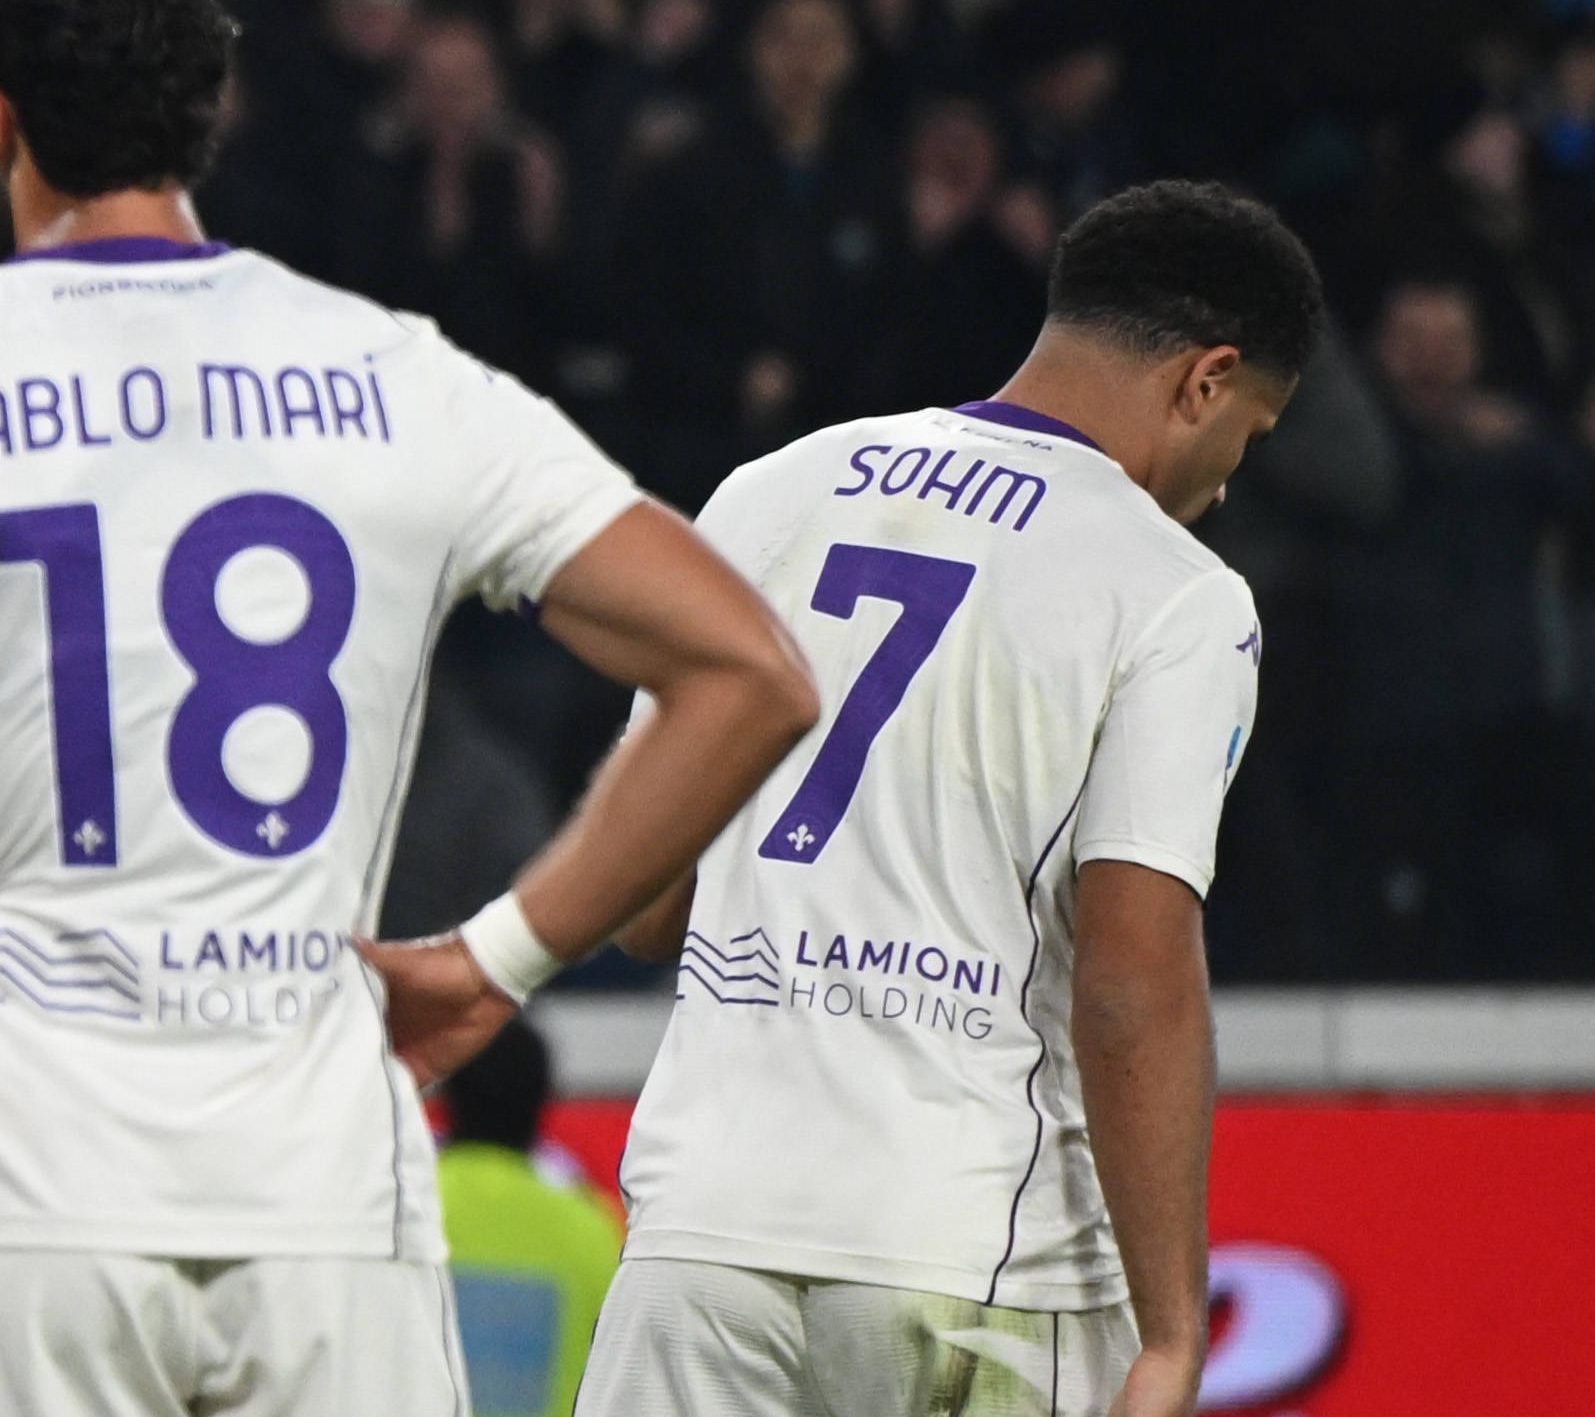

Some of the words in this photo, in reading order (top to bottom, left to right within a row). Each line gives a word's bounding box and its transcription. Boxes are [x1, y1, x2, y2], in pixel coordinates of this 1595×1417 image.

[836, 443, 1048, 532] SOHM
[759, 542, 978, 865] 7
[159, 932, 350, 973] LAMIO
[794, 929, 1003, 999] LAMIONI
[157, 985, 316, 1025] HOLD
[789, 975, 996, 1041] HOLDING
